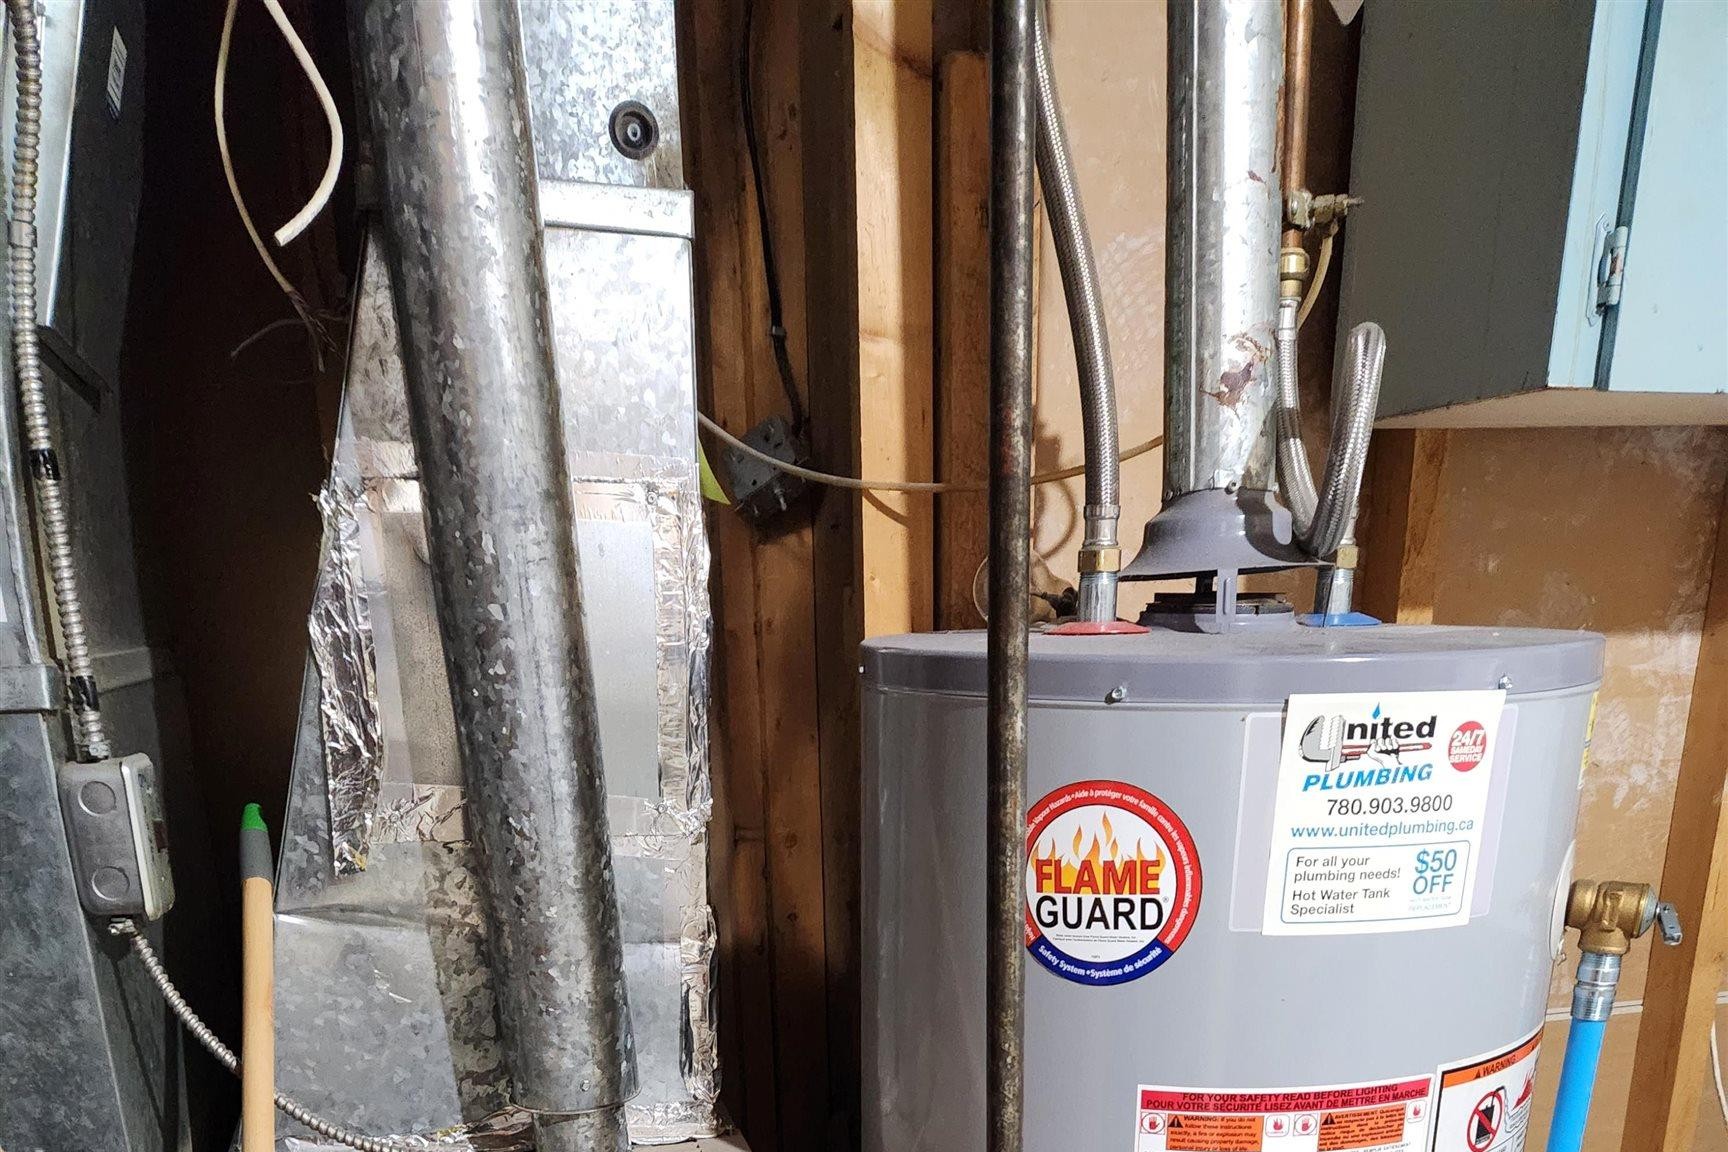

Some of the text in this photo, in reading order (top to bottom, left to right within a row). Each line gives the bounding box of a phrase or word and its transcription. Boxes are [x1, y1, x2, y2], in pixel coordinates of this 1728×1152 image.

[1451, 729, 1486, 744] 24/7
[1449, 754, 1482, 764] SERVICE
[1302, 763, 1433, 791] PLUMBING
[1075, 790, 1088, 799] Aide
[1094, 790, 1122, 800] protéger
[1123, 794, 1138, 806] votre
[1327, 795, 1453, 815] 780.903.9800
[1291, 820, 1474, 837] www.unitedplumbing.ca
[1296, 856, 1370, 868] For all your
[1415, 849, 1457, 874] $50
[1035, 859, 1160, 895] FLAME
[1294, 868, 1400, 884] plumbing needs!
[1413, 874, 1454, 895] OFF
[1292, 889, 1390, 901] Hot Water Tank
[1036, 895, 1163, 930] GUARD
[1290, 904, 1354, 916] Specialist
[1039, 946, 1162, 979] Safety System Système de sécurité
[1483, 1055, 1516, 1076] WARNING
[1147, 1100, 1174, 1109] POUR
[1177, 1102, 1210, 1110] VOTRE
[1264, 1102, 1292, 1110] LISEZ
[1293, 1100, 1324, 1109] AVANT
[1326, 1100, 1339, 1108] DE
[1341, 1096, 1376, 1106] METTRE
[1392, 1088, 1426, 1098] MARCHE
[1183, 1084, 1398, 1102] FOR YOUR SAFETY READ BEFORE LIGHTING
